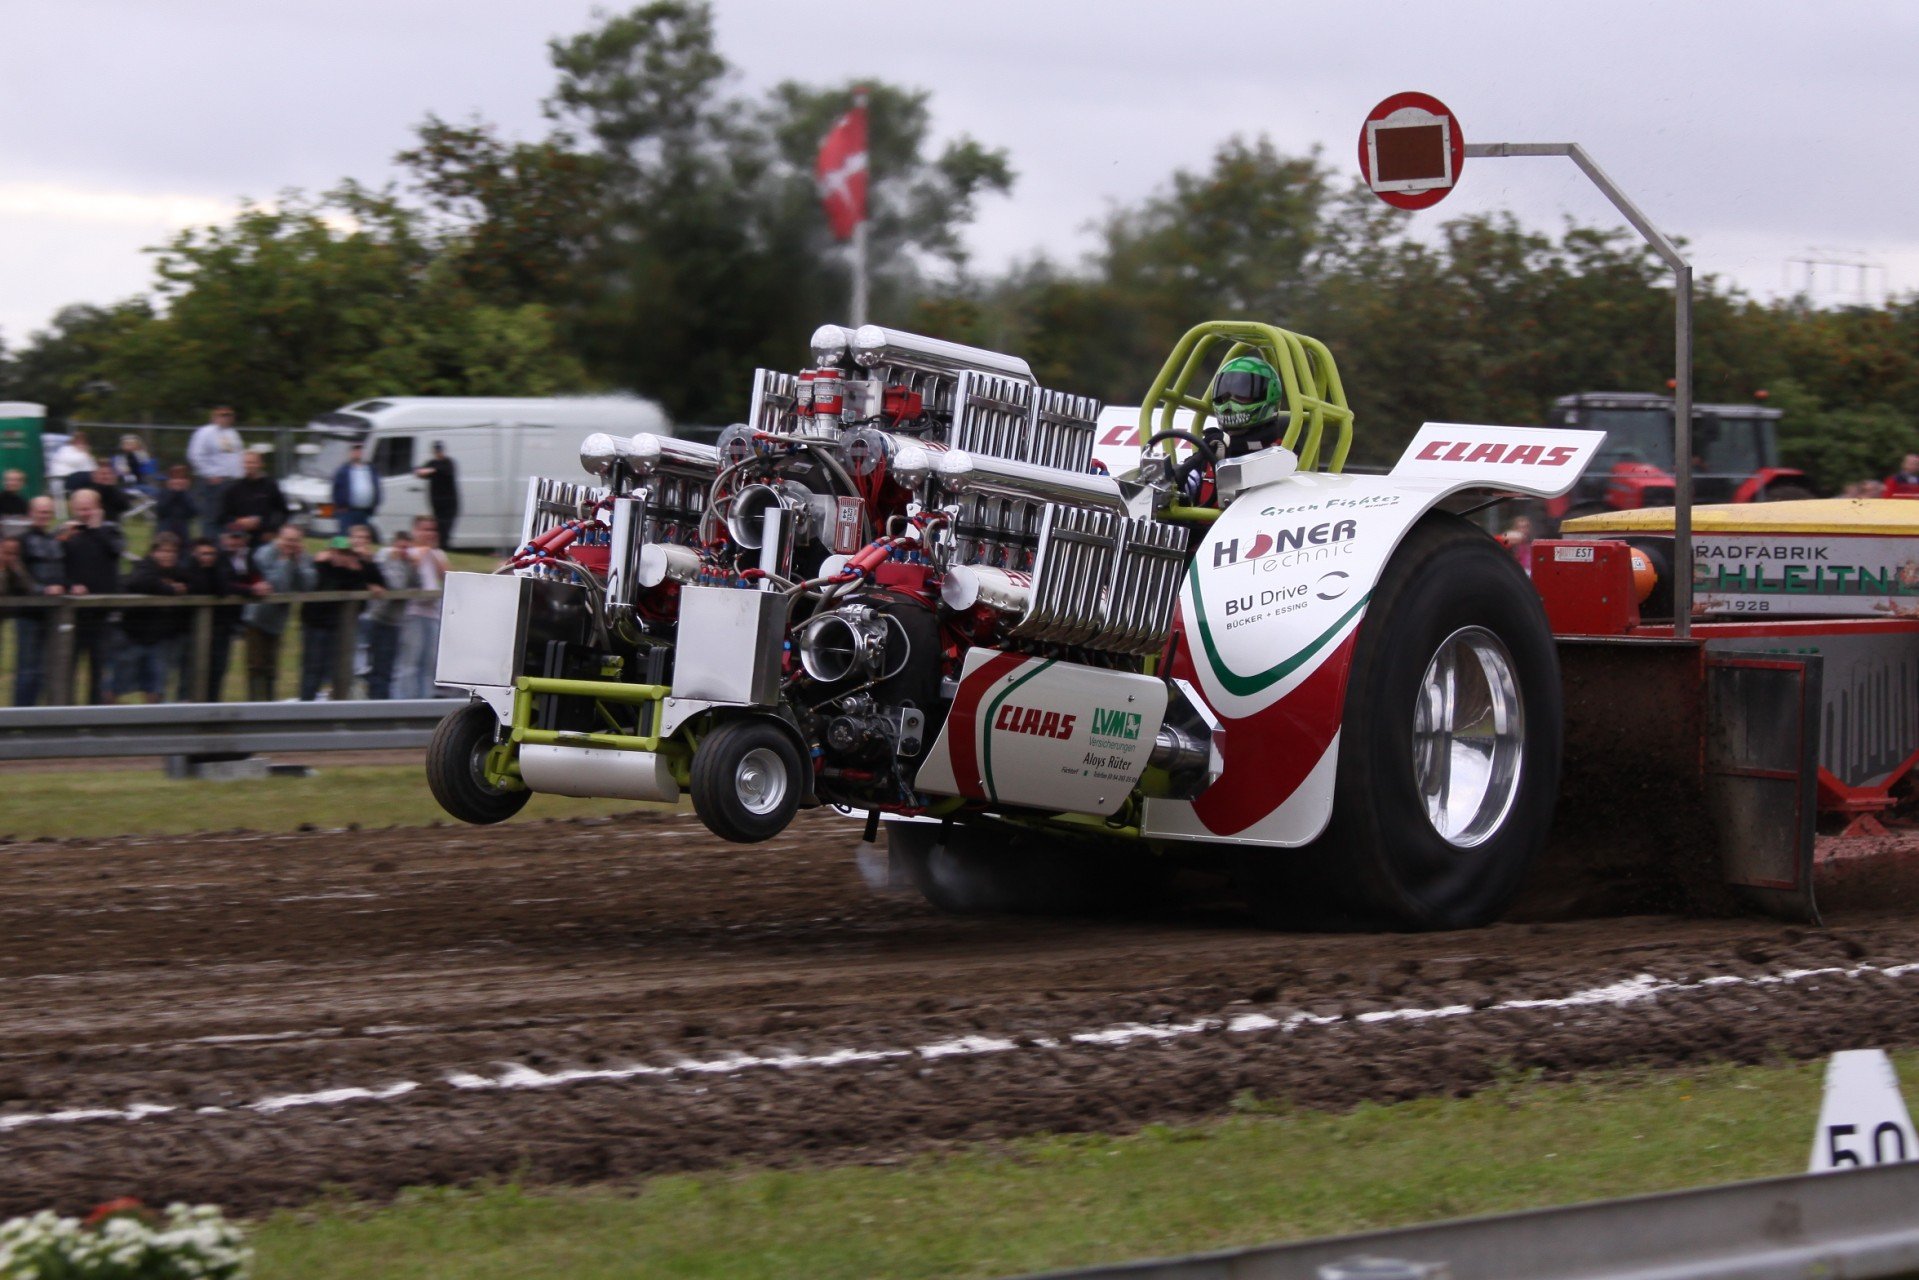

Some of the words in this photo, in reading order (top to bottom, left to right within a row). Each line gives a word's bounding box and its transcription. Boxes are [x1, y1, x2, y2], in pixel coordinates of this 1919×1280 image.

[1415, 441, 1579, 466] CLAAS
[1260, 504, 1319, 516] Green
[1252, 542, 1355, 575] Technic
[1225, 594, 1253, 616] BU
[1261, 584, 1308, 606] Drive
[1725, 600, 1770, 611] 1928
[1226, 613, 1263, 630] BÜCKER
[1275, 601, 1308, 616] ESSING
[995, 704, 1077, 740] CLAAS
[1092, 707, 1127, 738] LVM
[1089, 736, 1136, 754] Versicherungen
[1083, 752, 1106, 770] Aloys
[1107, 756, 1132, 771] Rüter
